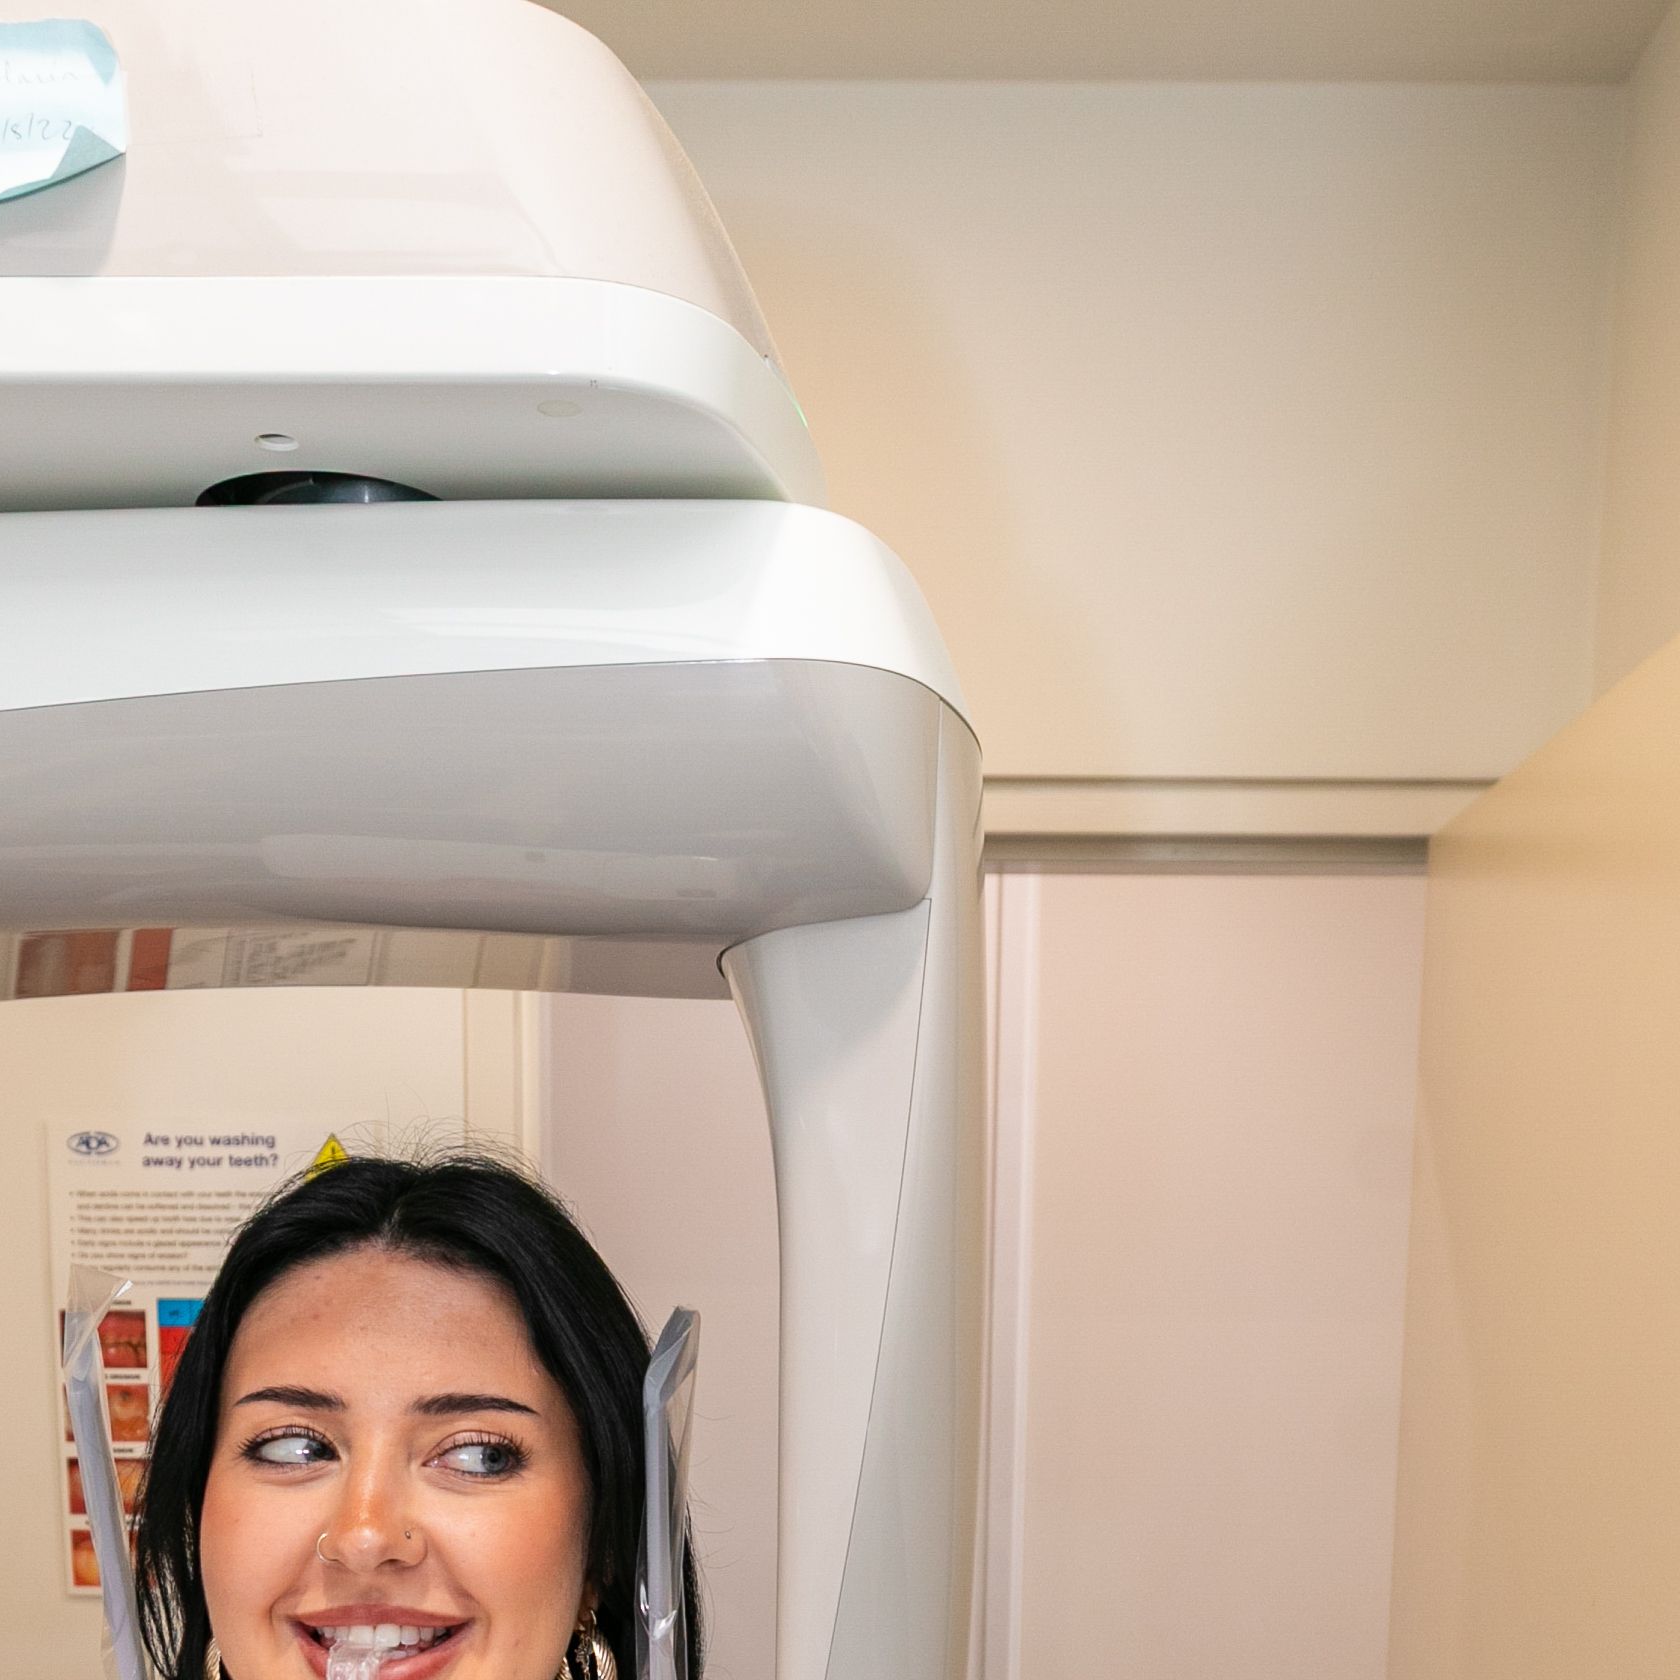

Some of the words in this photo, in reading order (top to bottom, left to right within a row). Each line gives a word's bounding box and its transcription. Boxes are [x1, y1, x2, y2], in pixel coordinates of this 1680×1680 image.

[143, 1132, 171, 1147] Are
[174, 1134, 204, 1150] you
[208, 1131, 276, 1150] washing
[142, 1155, 183, 1171] away
[188, 1155, 223, 1171] your
[228, 1153, 279, 1168] teeth?
